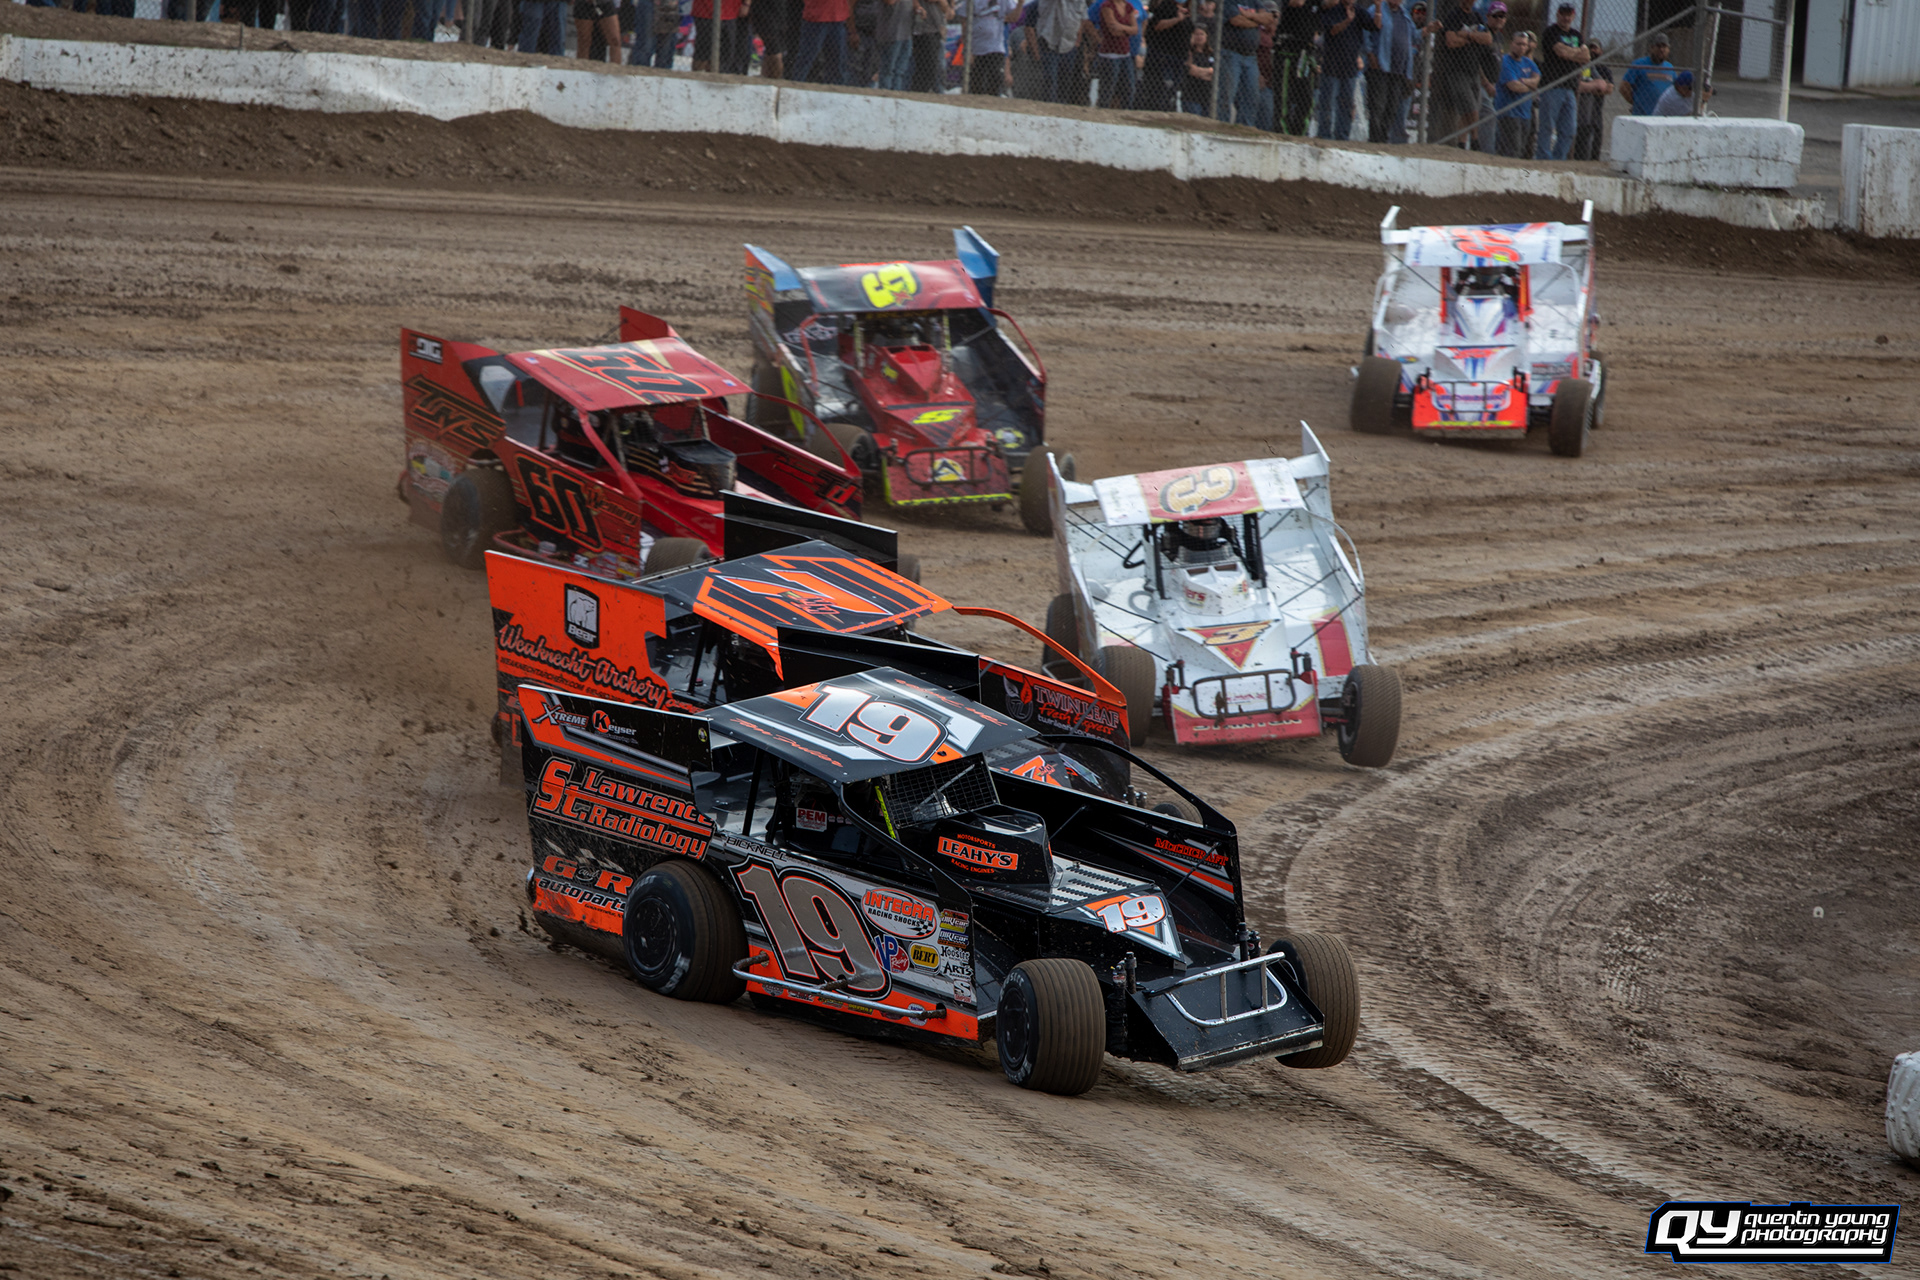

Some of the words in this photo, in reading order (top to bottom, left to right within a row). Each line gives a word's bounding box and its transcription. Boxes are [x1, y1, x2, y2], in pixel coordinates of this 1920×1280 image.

[515, 453, 604, 553] 60
[1160, 466, 1236, 515] 3
[567, 623, 597, 642] Bear
[498, 623, 596, 680] Weaknecht
[594, 659, 666, 710] Archery
[594, 712, 637, 736] Keyser
[804, 685, 942, 763] 19
[587, 803, 707, 860] Radiology
[797, 808, 827, 823] PEM
[726, 836, 787, 863] BICKNELL
[942, 839, 1014, 867] LEAHY'S
[957, 833, 996, 849] MOTORSPORTS
[542, 855, 578, 880] G
[594, 869, 634, 896] R
[864, 890, 934, 922] INTEGRA
[867, 907, 893, 920] RACING
[893, 914, 921, 927] SHOCKS
[1096, 894, 1166, 934] 19
[735, 862, 888, 993] 19
[874, 934, 899, 972] VP
[912, 949, 938, 964] BERT
